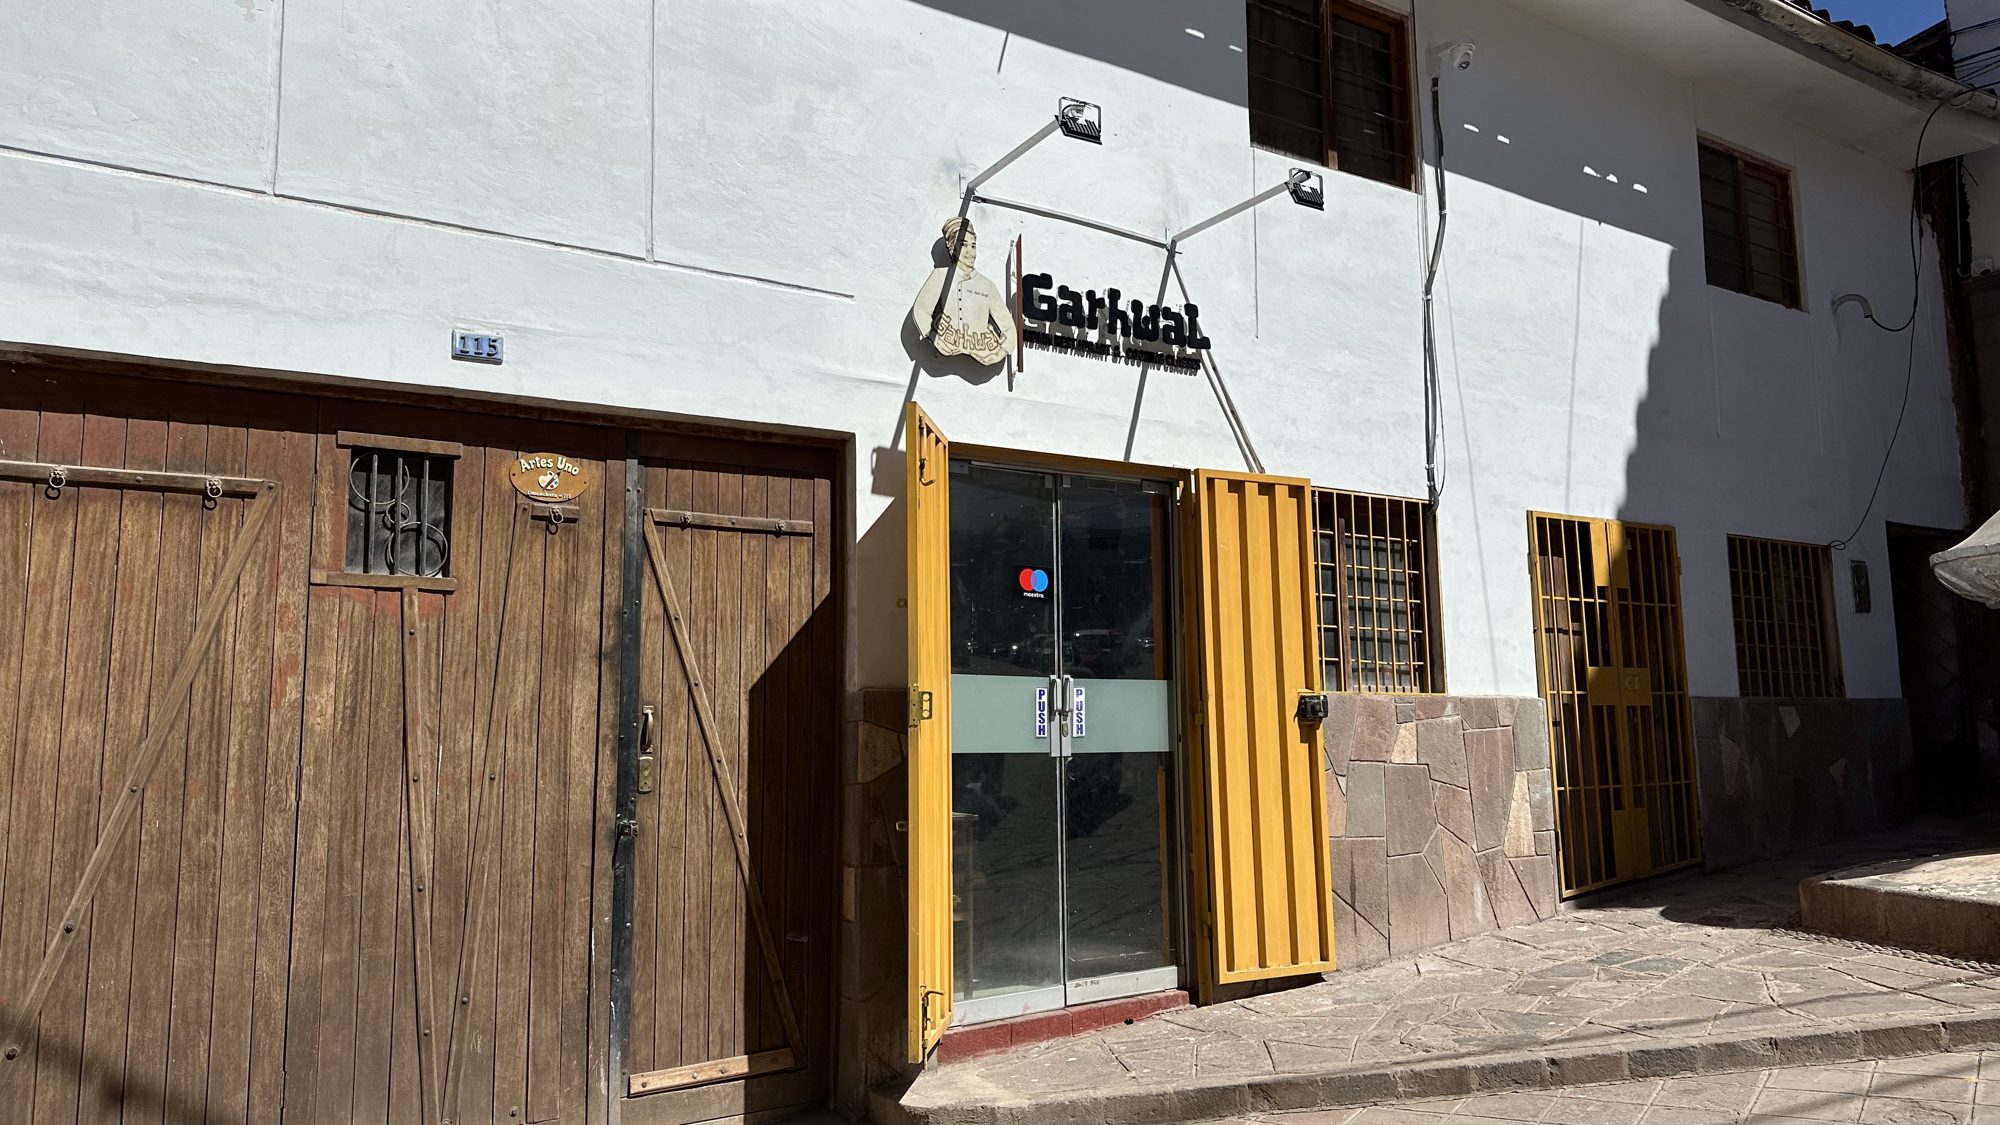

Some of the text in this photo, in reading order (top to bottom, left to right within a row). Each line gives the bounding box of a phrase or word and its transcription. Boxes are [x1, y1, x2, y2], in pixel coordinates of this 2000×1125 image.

[459, 336, 498, 357] 115
[520, 456, 580, 476] Artes Uno
[1038, 689, 1046, 736] PUSH
[1075, 689, 1084, 735] PUSH
